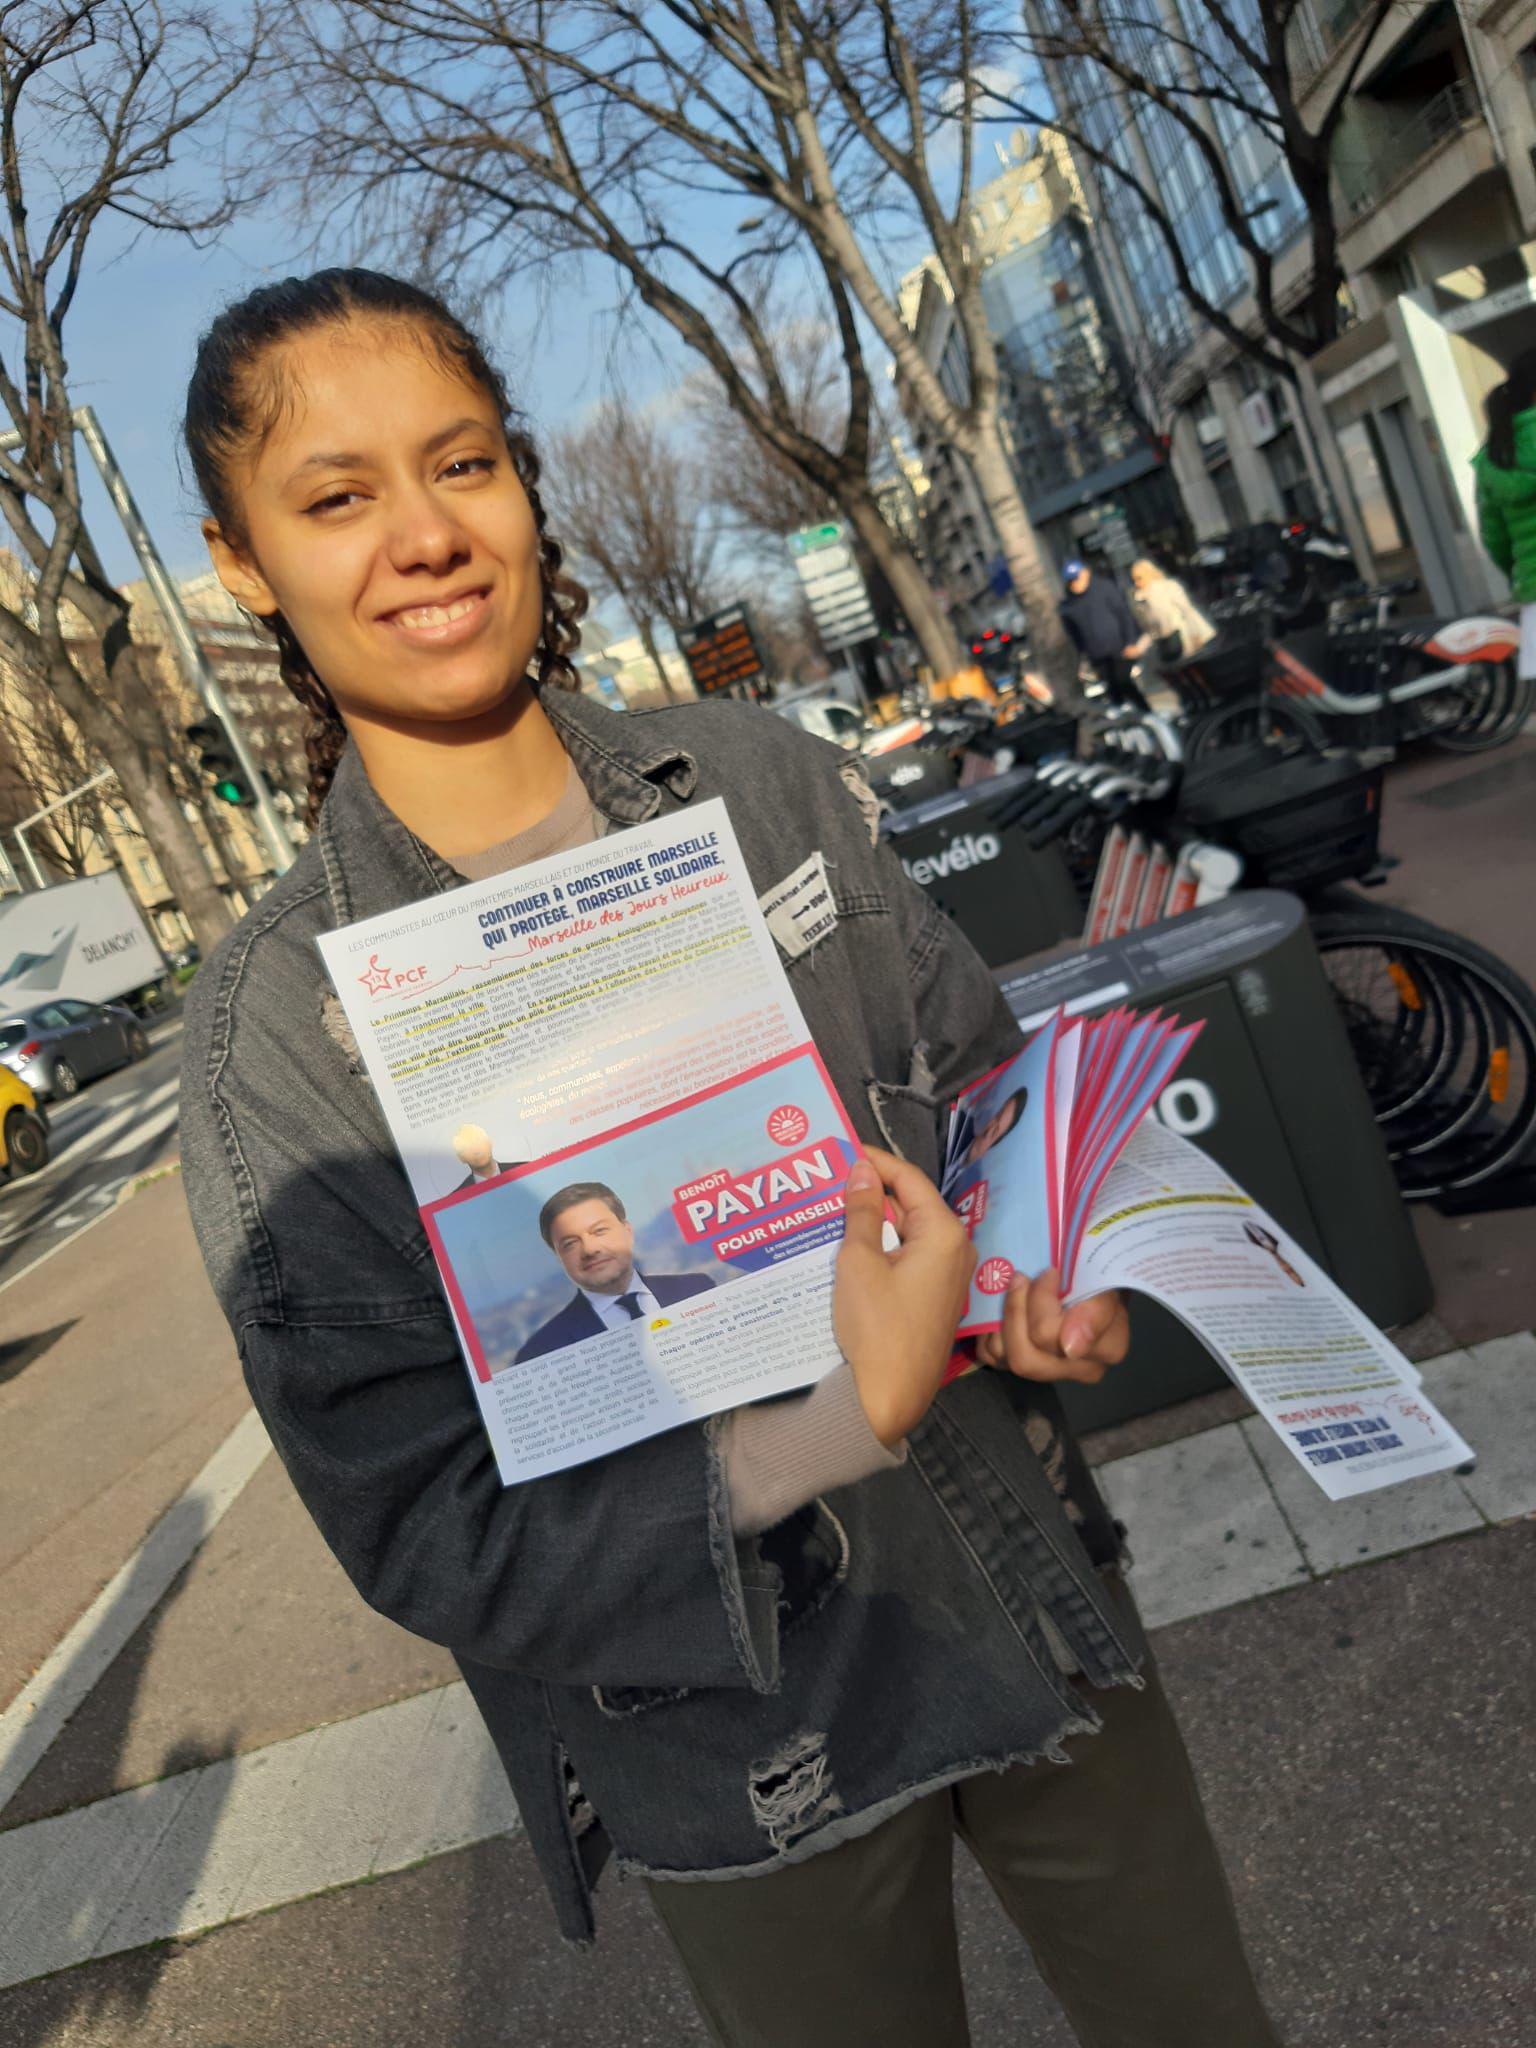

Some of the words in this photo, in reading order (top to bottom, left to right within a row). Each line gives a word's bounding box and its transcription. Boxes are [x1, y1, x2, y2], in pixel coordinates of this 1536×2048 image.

[346, 939, 365, 953] LES
[362, 919, 422, 948] COMMUNISTES
[418, 915, 433, 928] AU
[430, 907, 457, 924] CŒUR
[454, 902, 470, 915] DU
[467, 886, 514, 911] PRINTEMPS
[511, 870, 563, 896] MARSEILLAIS
[560, 866, 573, 878] ET
[571, 861, 586, 874] DU
[583, 852, 614, 870] MONDE
[611, 848, 625, 861] DU
[622, 837, 656, 857] TRAVAIL
[476, 891, 551, 930] CONTINUER
[550, 882, 564, 902] À
[564, 857, 646, 897] CONSTRUIRE
[645, 830, 719, 868] MARSEILLE
[480, 926, 509, 951] QUI
[506, 899, 575, 940] PROTÈGE,
[574, 875, 652, 914] MARSEILLE
[651, 848, 726, 888] SOLIDAIRE,
[526, 915, 598, 954] Marseille
[596, 904, 626, 928] des
[625, 889, 669, 918] Jours
[368, 1016, 381, 1027] Le
[382, 1002, 422, 1024] Printemps
[469, 963, 528, 991] rassemblement
[527, 957, 544, 970] des
[544, 948, 569, 964] forces
[570, 943, 583, 954] de
[392, 963, 430, 988] PCF
[408, 1050, 427, 1063] ville
[427, 1042, 447, 1057] peut
[446, 1036, 464, 1049] être
[463, 1024, 497, 1044] toujours
[496, 1017, 515, 1032] plus
[514, 1014, 527, 1024] un
[527, 1006, 546, 1020] pôle
[557, 987, 596, 1008] résistance
[389, 1061, 422, 1079] meilleur
[677, 1169, 727, 1201] BENOÎT
[685, 1147, 835, 1234] PAYAN
[715, 1224, 768, 1255] POUR
[768, 1194, 845, 1236] MARSEILL
[764, 1244, 774, 1254] Le
[772, 1225, 826, 1251] rassemblement
[825, 1220, 837, 1232] de
[771, 1250, 786, 1261] des
[785, 1234, 824, 1257] écologistes
